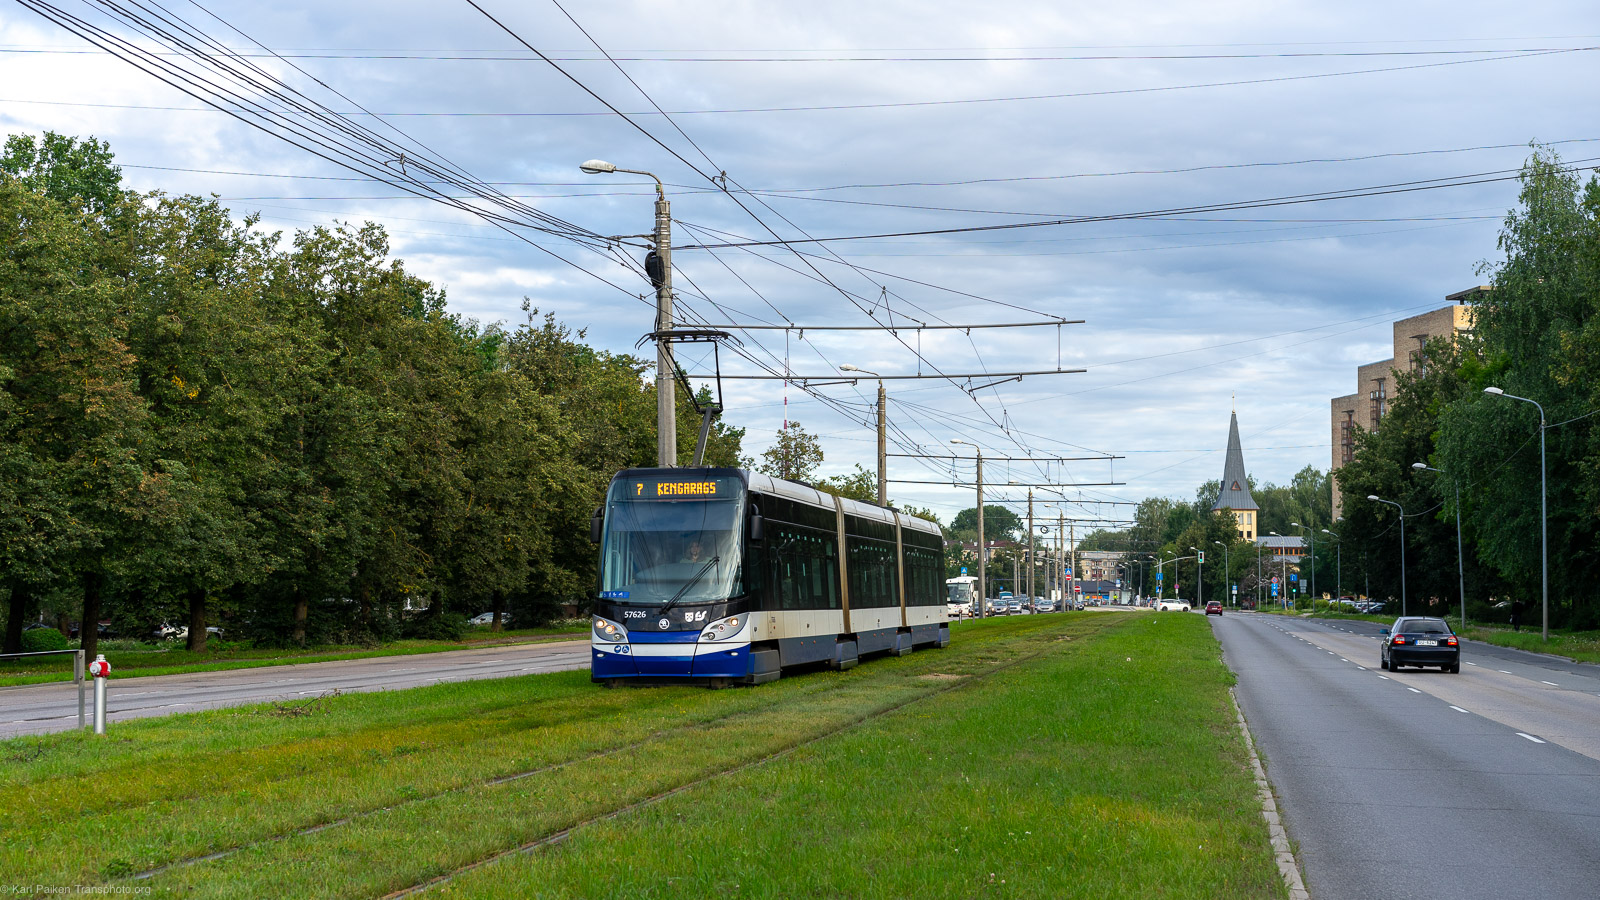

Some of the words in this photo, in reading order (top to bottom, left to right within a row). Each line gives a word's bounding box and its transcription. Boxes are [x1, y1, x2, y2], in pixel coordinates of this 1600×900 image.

[636, 483, 644, 496] 7
[657, 482, 716, 496] ĶENGARAGS
[624, 610, 647, 618] 57626
